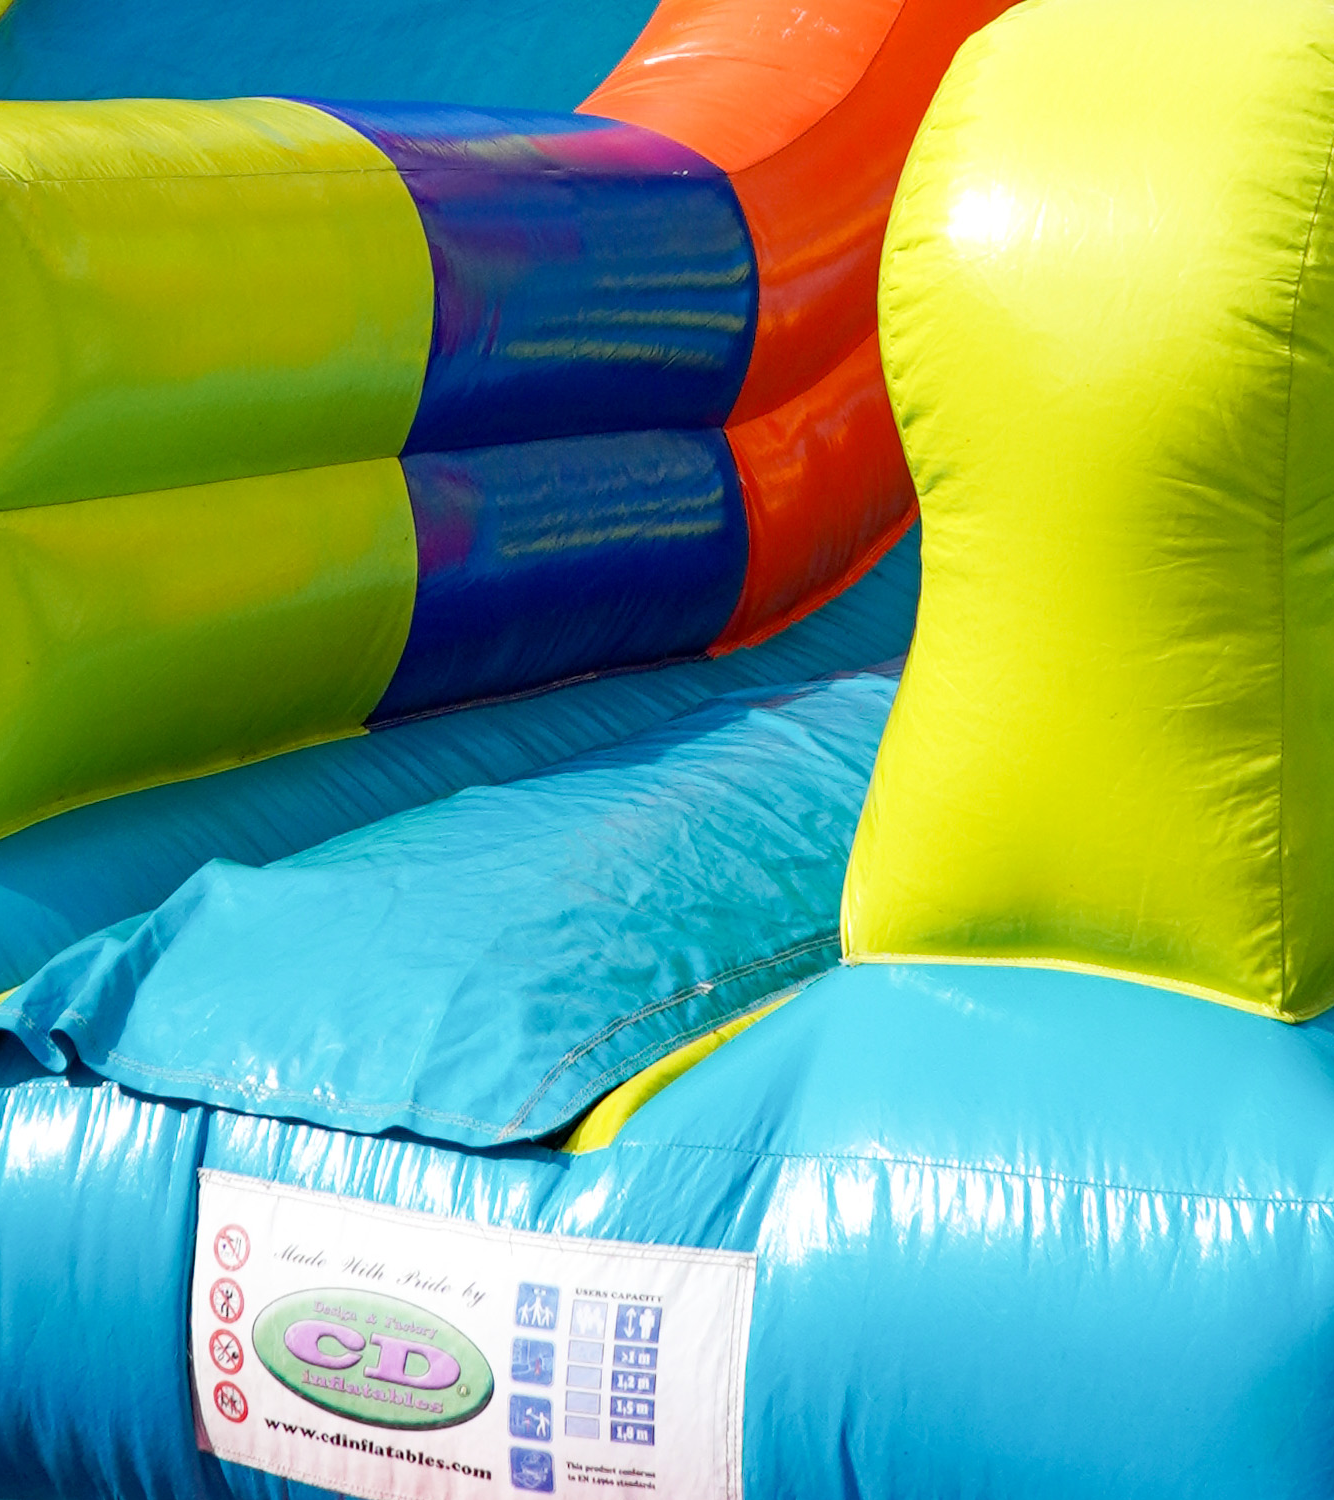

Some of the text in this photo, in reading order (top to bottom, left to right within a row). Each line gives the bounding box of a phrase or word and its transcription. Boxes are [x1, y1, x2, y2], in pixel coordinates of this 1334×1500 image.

[273, 1243, 489, 1307] Made With Pride by
[575, 1288, 663, 1302] USERS CAPACITY
[313, 1301, 439, 1339] Design & Factory
[284, 1319, 461, 1390] CD
[301, 1369, 444, 1414] inflatables
[618, 1374, 635, 1391] 1,2
[616, 1400, 649, 1416] 1,5 m
[264, 1416, 492, 1480] www.cdinflatables.com
[636, 1428, 648, 1441] m
[566, 1462, 583, 1471] This
